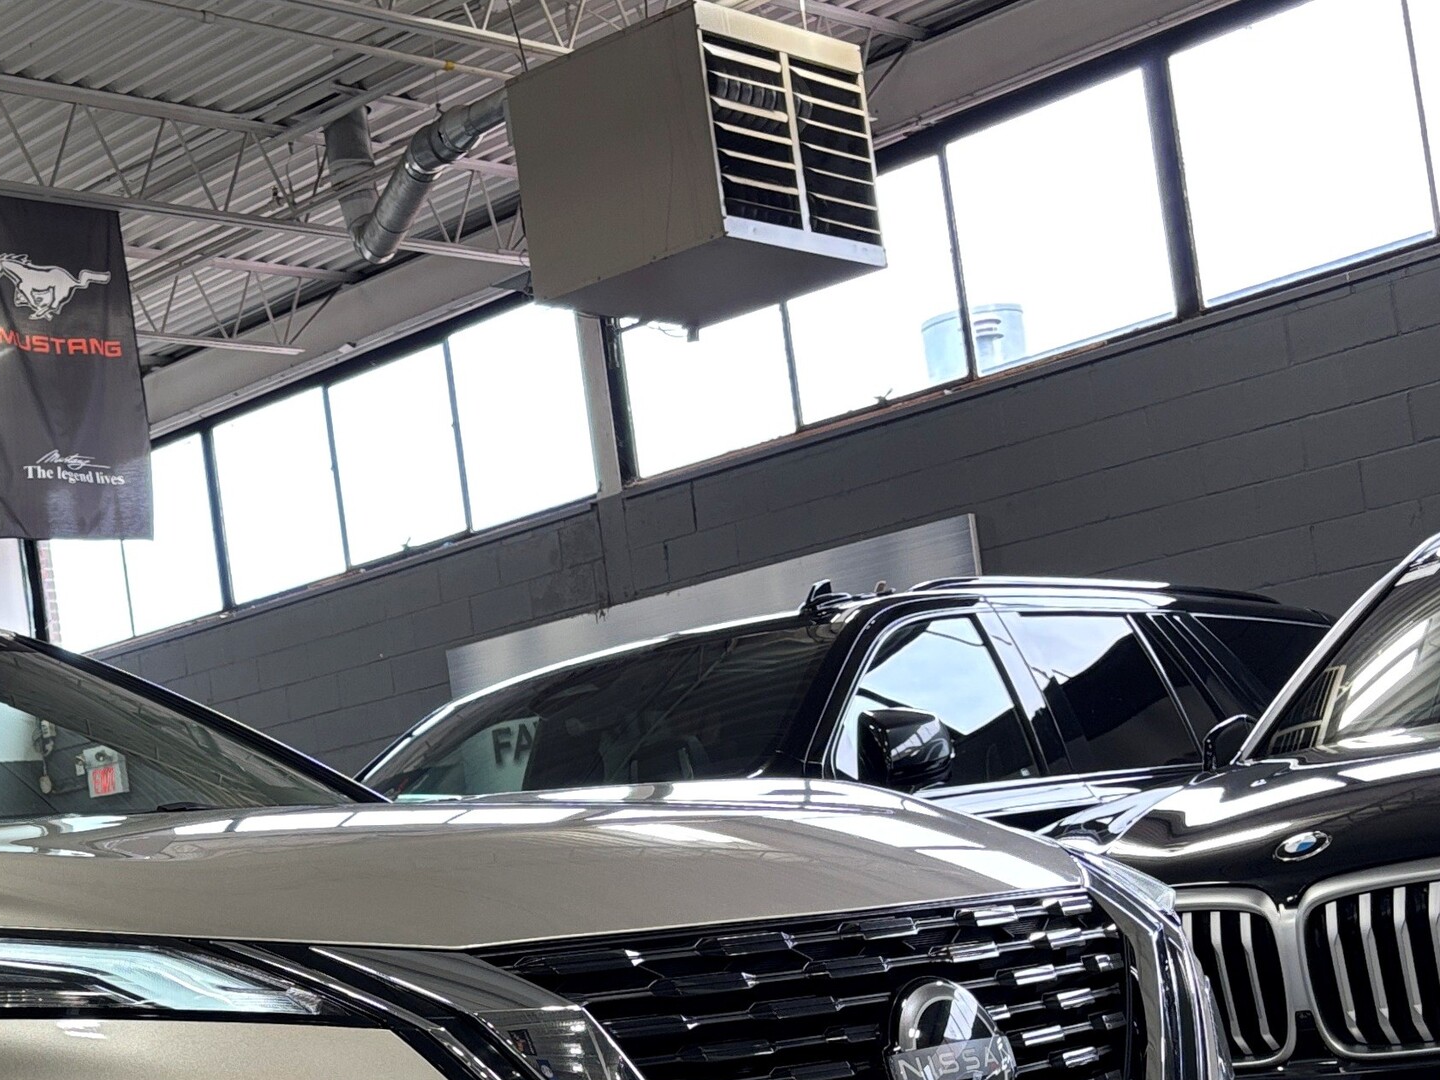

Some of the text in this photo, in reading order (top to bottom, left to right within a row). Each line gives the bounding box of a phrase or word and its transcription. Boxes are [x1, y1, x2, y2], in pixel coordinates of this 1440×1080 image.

[23, 466, 125, 485] The legend lives
